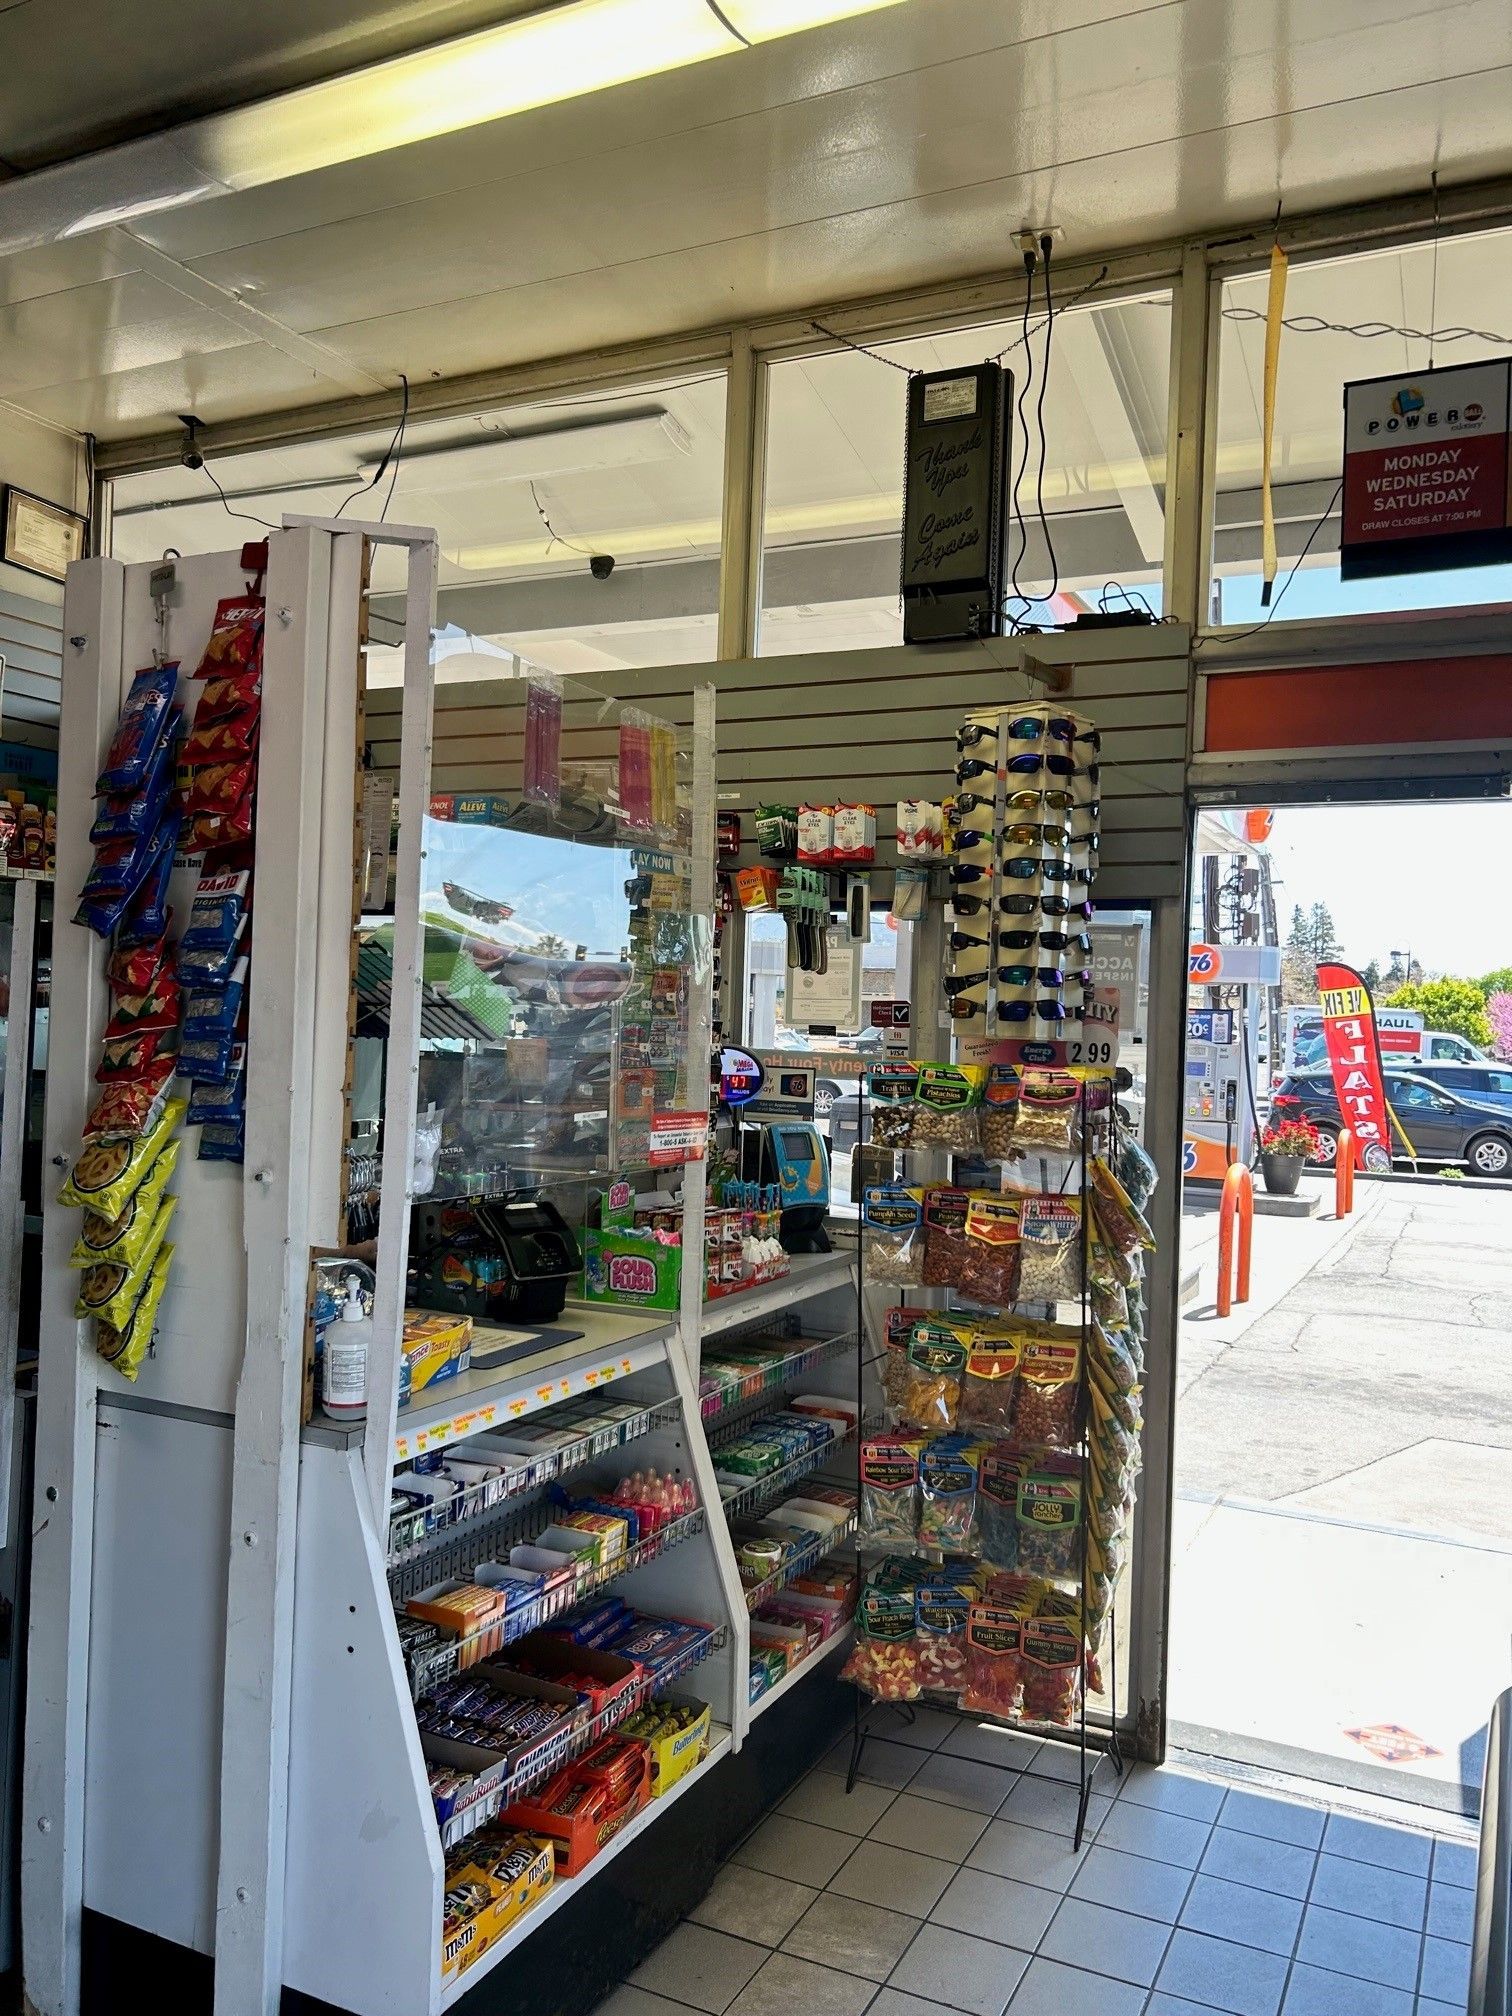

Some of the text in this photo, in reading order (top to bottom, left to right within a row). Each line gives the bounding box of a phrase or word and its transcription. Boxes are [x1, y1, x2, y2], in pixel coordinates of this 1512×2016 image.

[915, 428, 984, 473] Thank
[1384, 449, 1462, 472] MONDAY
[925, 463, 969, 497] You
[1366, 466, 1479, 493] WEDNESDAY
[1374, 487, 1471, 511] SATURDAY
[918, 506, 974, 543] Come
[1362, 520, 1389, 531] DRAW
[1391, 516, 1430, 527] CLOSES
[1431, 514, 1442, 523] AT
[1466, 510, 1482, 519] PM
[912, 529, 979, 572] Again
[459, 802, 486, 812] ALEVE
[652, 854, 671, 870] NOW
[1023, 1046, 1052, 1055] Energy
[1028, 1054, 1047, 1062] Club
[1072, 1043, 1111, 1063] 2.99
[731, 1076, 746, 1088] 47
[897, 1210, 916, 1219] Seeds
[612, 1258, 654, 1277] SOUR
[1033, 1502, 1061, 1512] JOLLY
[1034, 1510, 1062, 1519] rancher
[414, 1628, 437, 1645] HALLS
[976, 1631, 1016, 1643] Fruit Slices
[1026, 1638, 1051, 1649] Gummy
